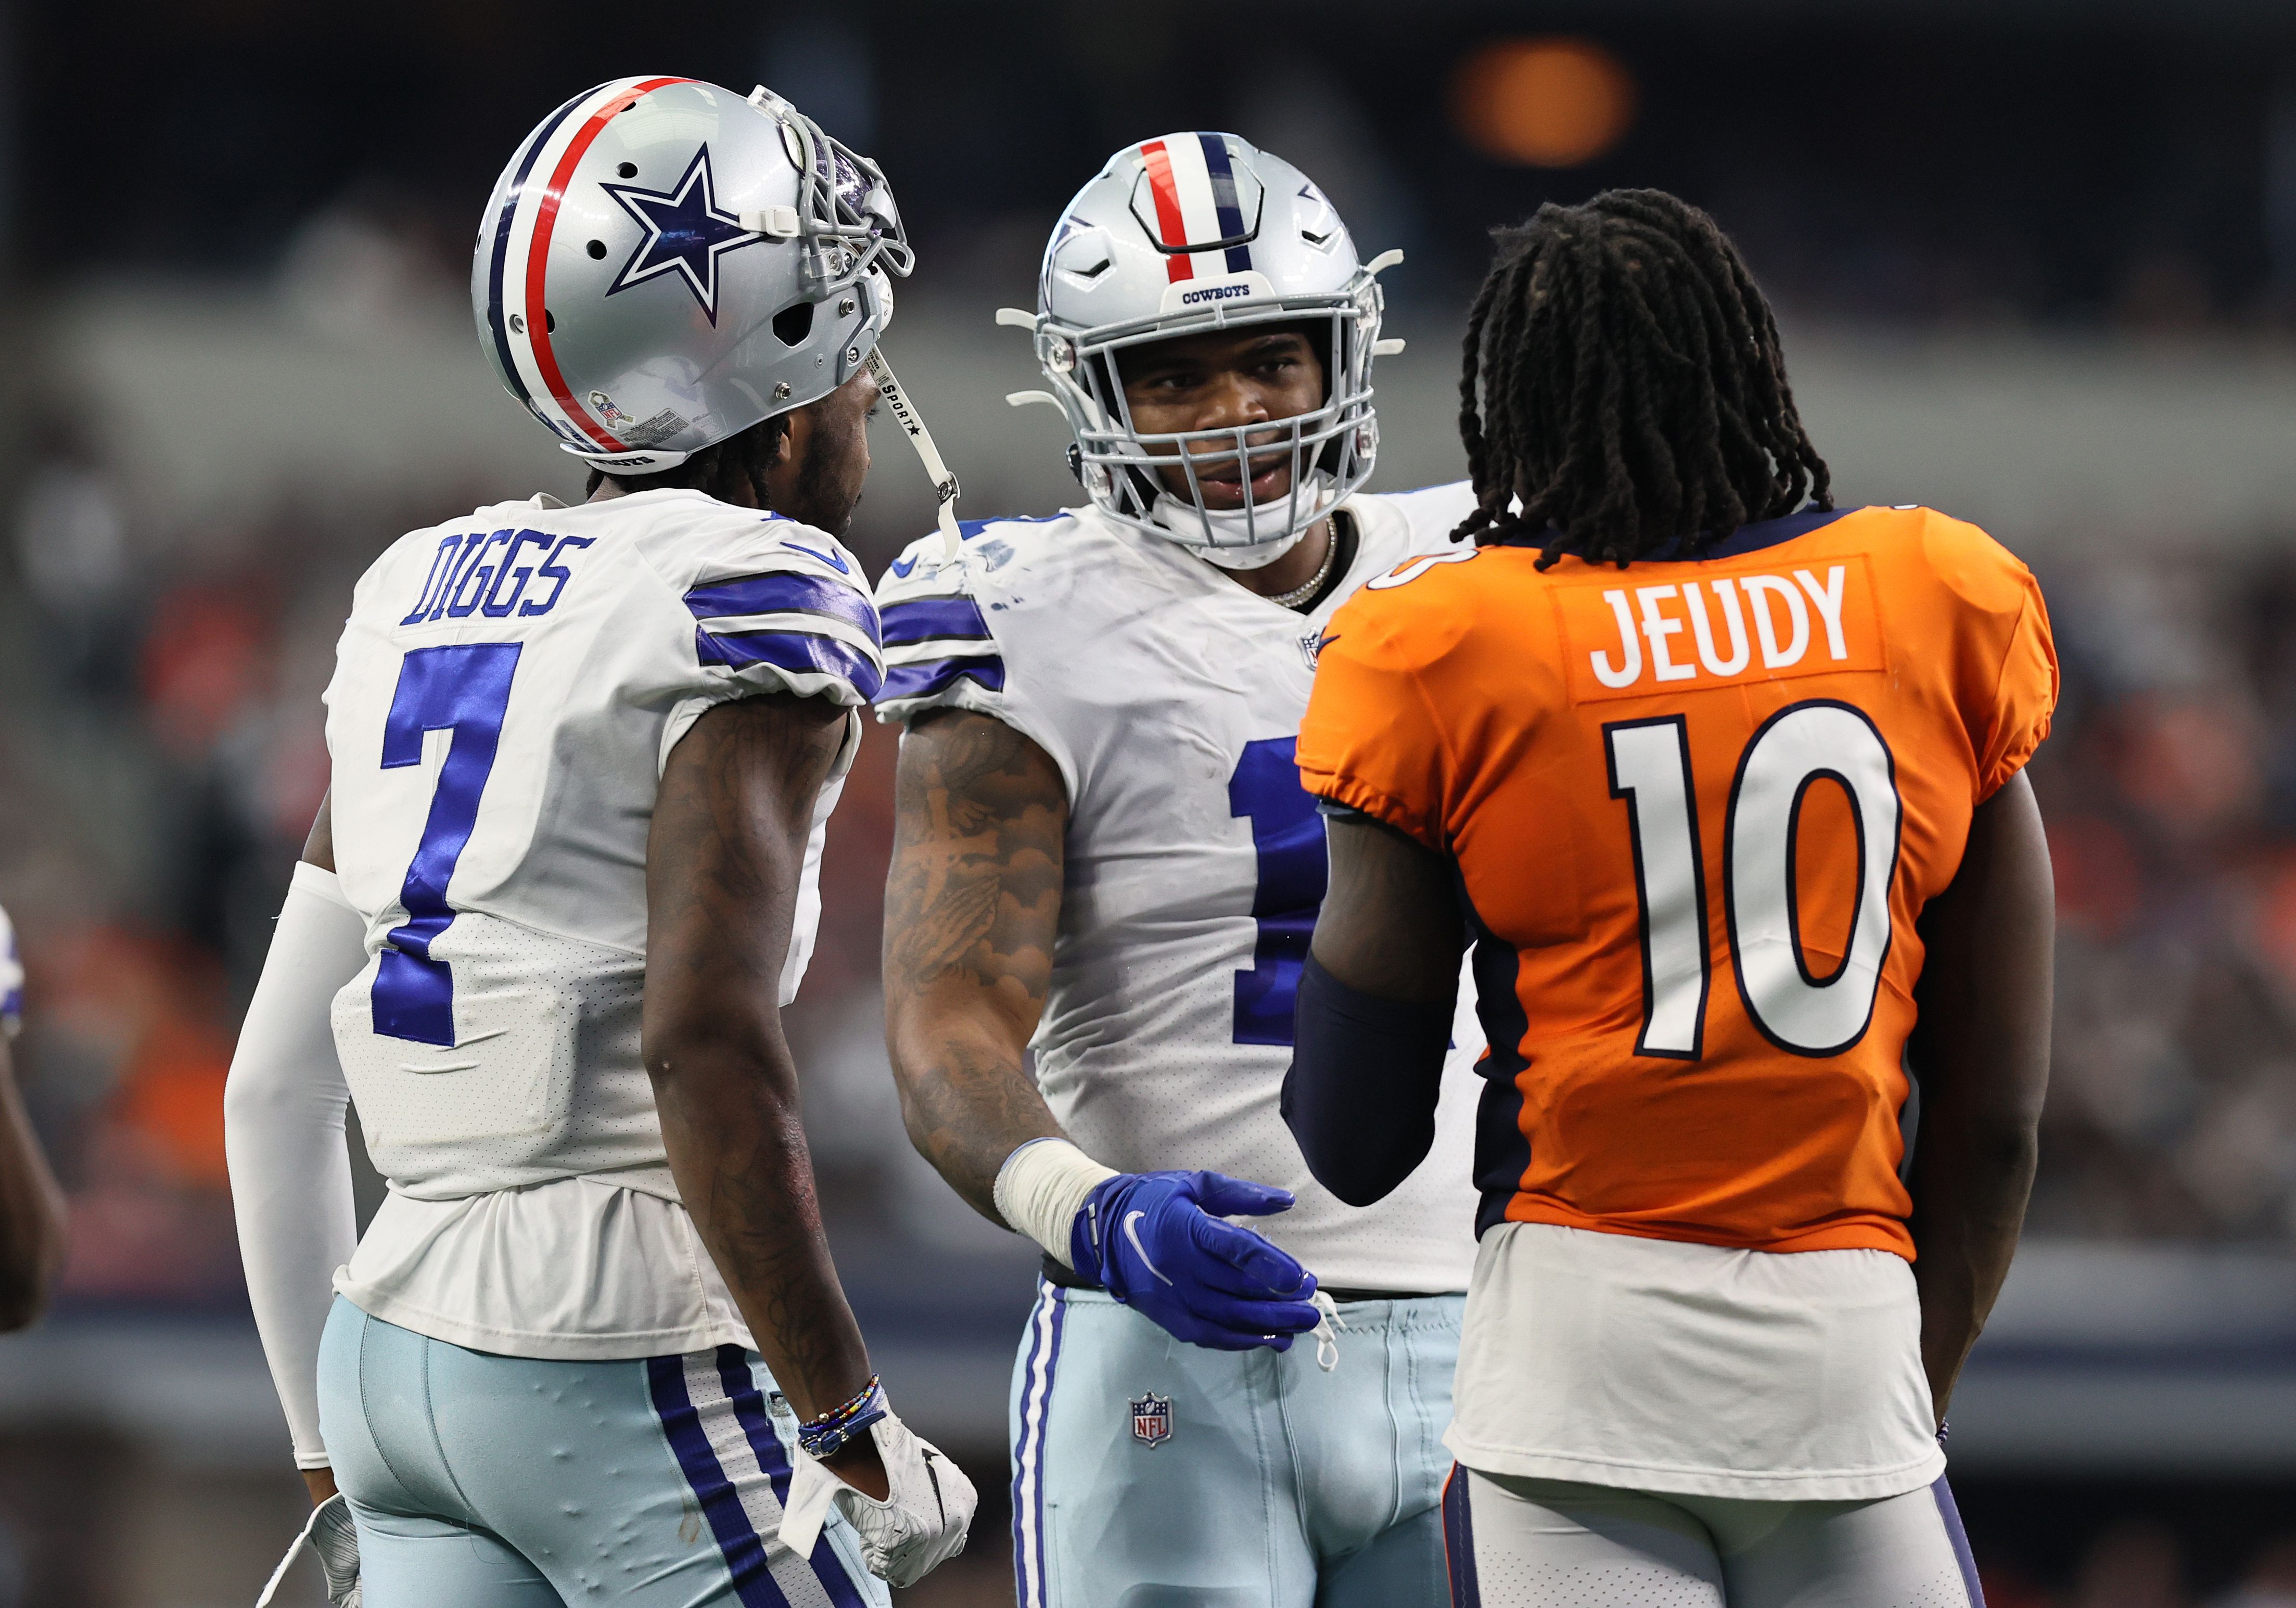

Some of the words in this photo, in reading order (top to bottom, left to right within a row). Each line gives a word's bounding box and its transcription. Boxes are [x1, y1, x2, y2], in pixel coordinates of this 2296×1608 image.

[1183, 285, 1249, 304] COWBOYS
[602, 409, 619, 419] NFL
[630, 417, 657, 431] WARNING
[882, 385, 914, 425] SPORT
[399, 529, 596, 626] DIGGS
[1590, 565, 1847, 688] JEUDY
[373, 641, 523, 1047] 7
[1601, 697, 1902, 1061] 10
[1136, 1417, 1166, 1438] NFL
